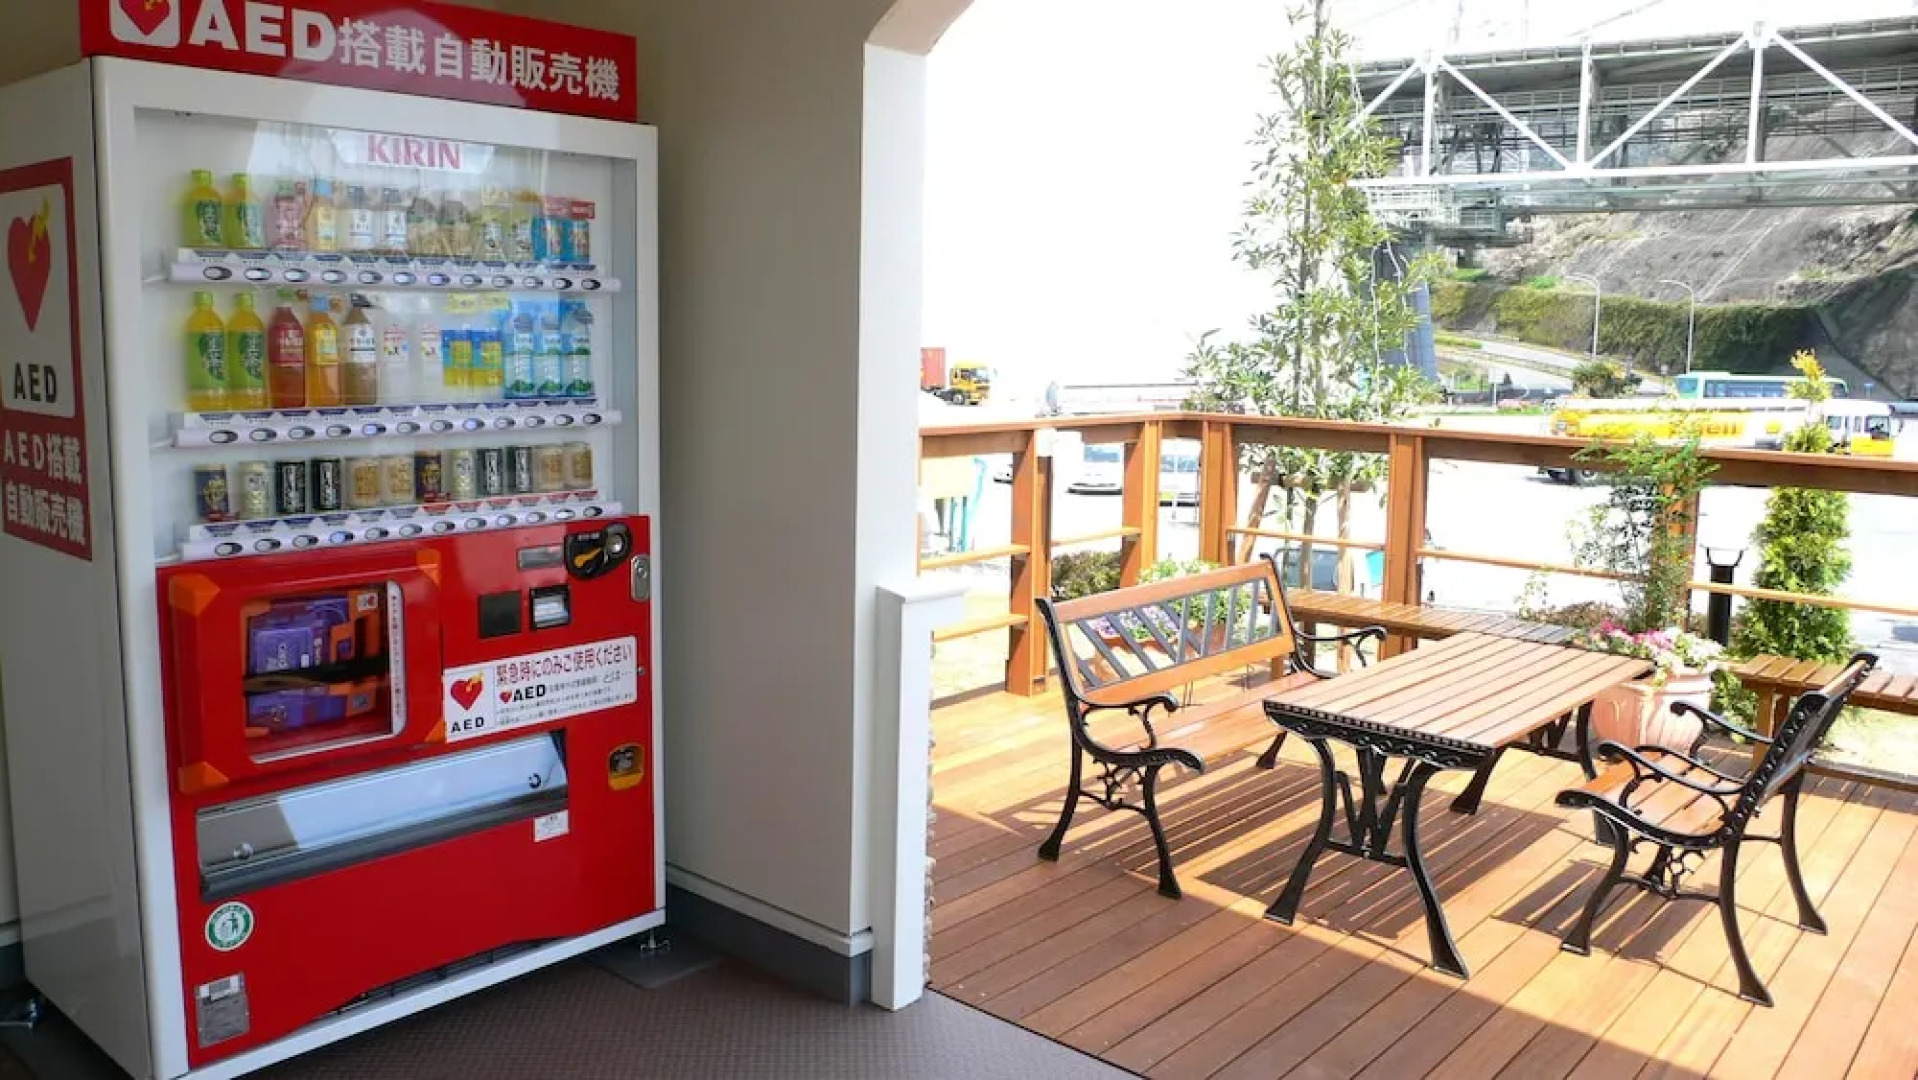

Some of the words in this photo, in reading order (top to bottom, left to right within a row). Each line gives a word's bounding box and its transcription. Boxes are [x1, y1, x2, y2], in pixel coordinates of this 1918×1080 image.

[367, 134, 461, 169] KIRIN
[14, 362, 57, 403] AED
[514, 684, 546, 702] AED
[451, 717, 484, 733] AED
